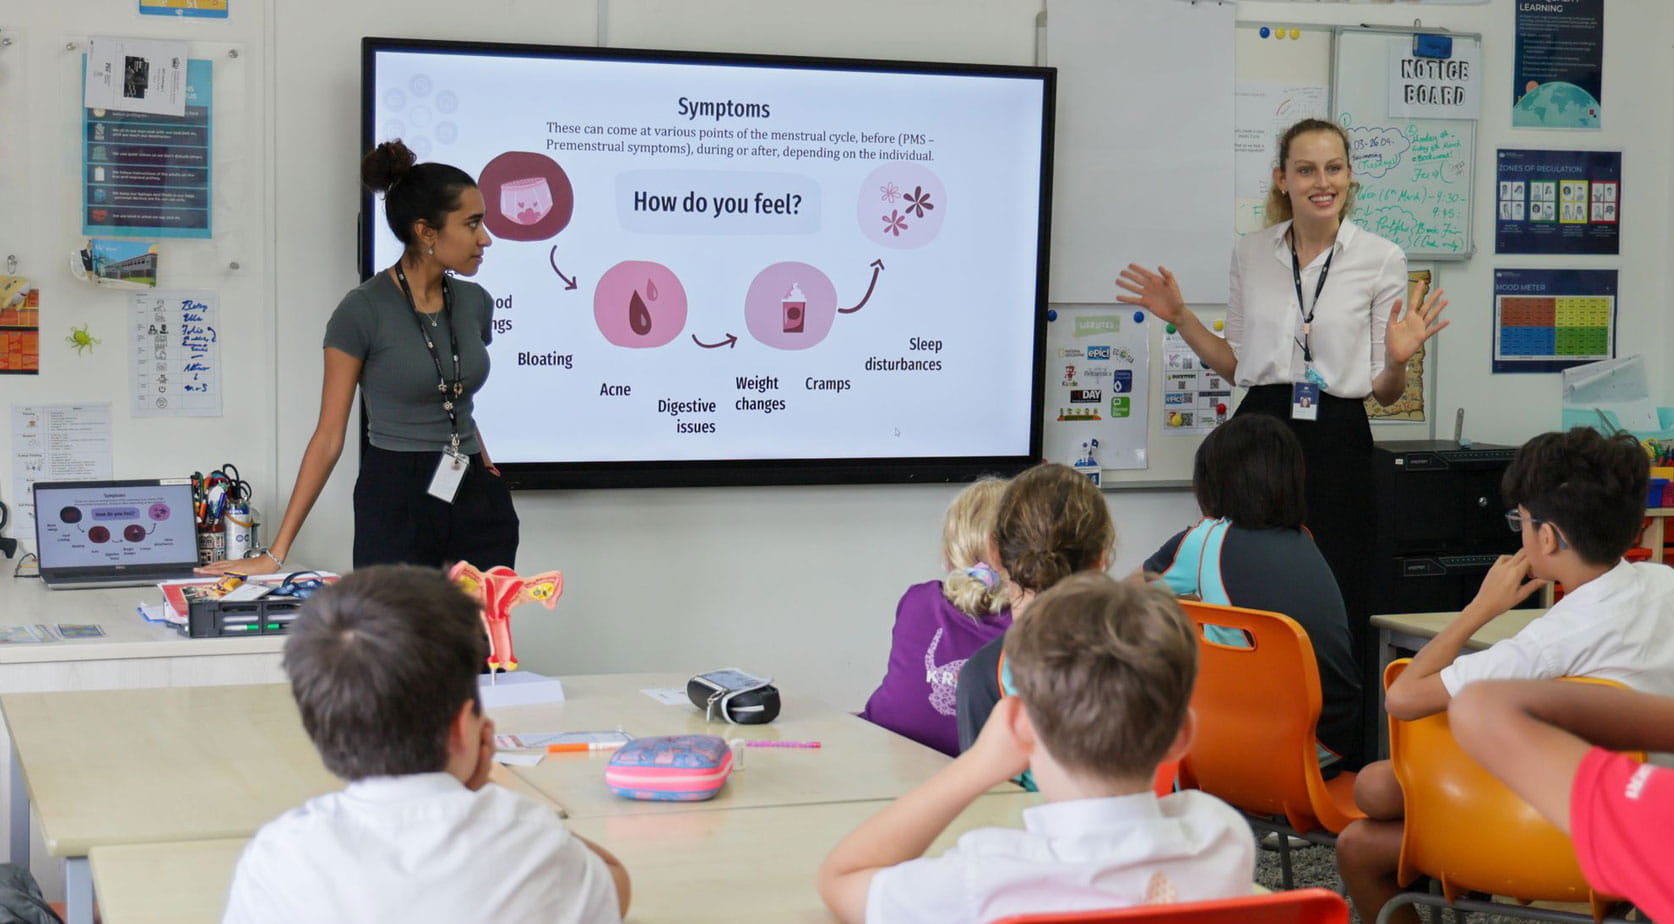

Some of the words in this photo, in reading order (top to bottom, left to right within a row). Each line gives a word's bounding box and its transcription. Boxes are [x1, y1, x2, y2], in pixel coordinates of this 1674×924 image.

[1520, 3, 1563, 13] LEARNING
[1401, 59, 1470, 81] NOTICE
[1404, 85, 1465, 106] BOARD
[678, 97, 770, 121] Symptoms
[546, 122, 581, 134] These
[584, 125, 604, 135] can
[607, 126, 638, 136] come
[640, 127, 651, 136] at
[654, 127, 696, 137] various
[699, 128, 734, 141] points
[737, 128, 748, 139] of
[750, 129, 768, 140] the
[771, 131, 826, 142] menstrual
[829, 132, 859, 146] cycle,
[861, 132, 896, 144] before
[898, 133, 926, 146] (PMS
[546, 139, 625, 152] Premenstrual
[627, 143, 694, 156] symptoms),
[697, 144, 734, 158] during
[737, 147, 748, 156] or
[751, 146, 780, 158] after,
[783, 147, 840, 161] depending
[842, 151, 856, 159] on
[859, 149, 876, 160] the
[879, 149, 934, 161] individual.
[1498, 164, 1523, 172] ZONES
[1536, 165, 1582, 173] REGULATION
[634, 191, 677, 212] How
[683, 191, 707, 213] do
[713, 196, 748, 219] you
[754, 193, 802, 215] feel?
[1496, 283, 1518, 291] MOOD
[495, 294, 513, 309] od
[909, 337, 943, 353] Sleep
[518, 351, 573, 369] Bloating
[865, 356, 942, 371] disturbances
[600, 383, 632, 396] Acne
[736, 375, 779, 392] Weight
[805, 377, 851, 393] Cramps
[1082, 390, 1101, 399] DAY
[658, 398, 716, 415] Digestive
[735, 397, 786, 414] changes
[676, 419, 716, 433] issues
